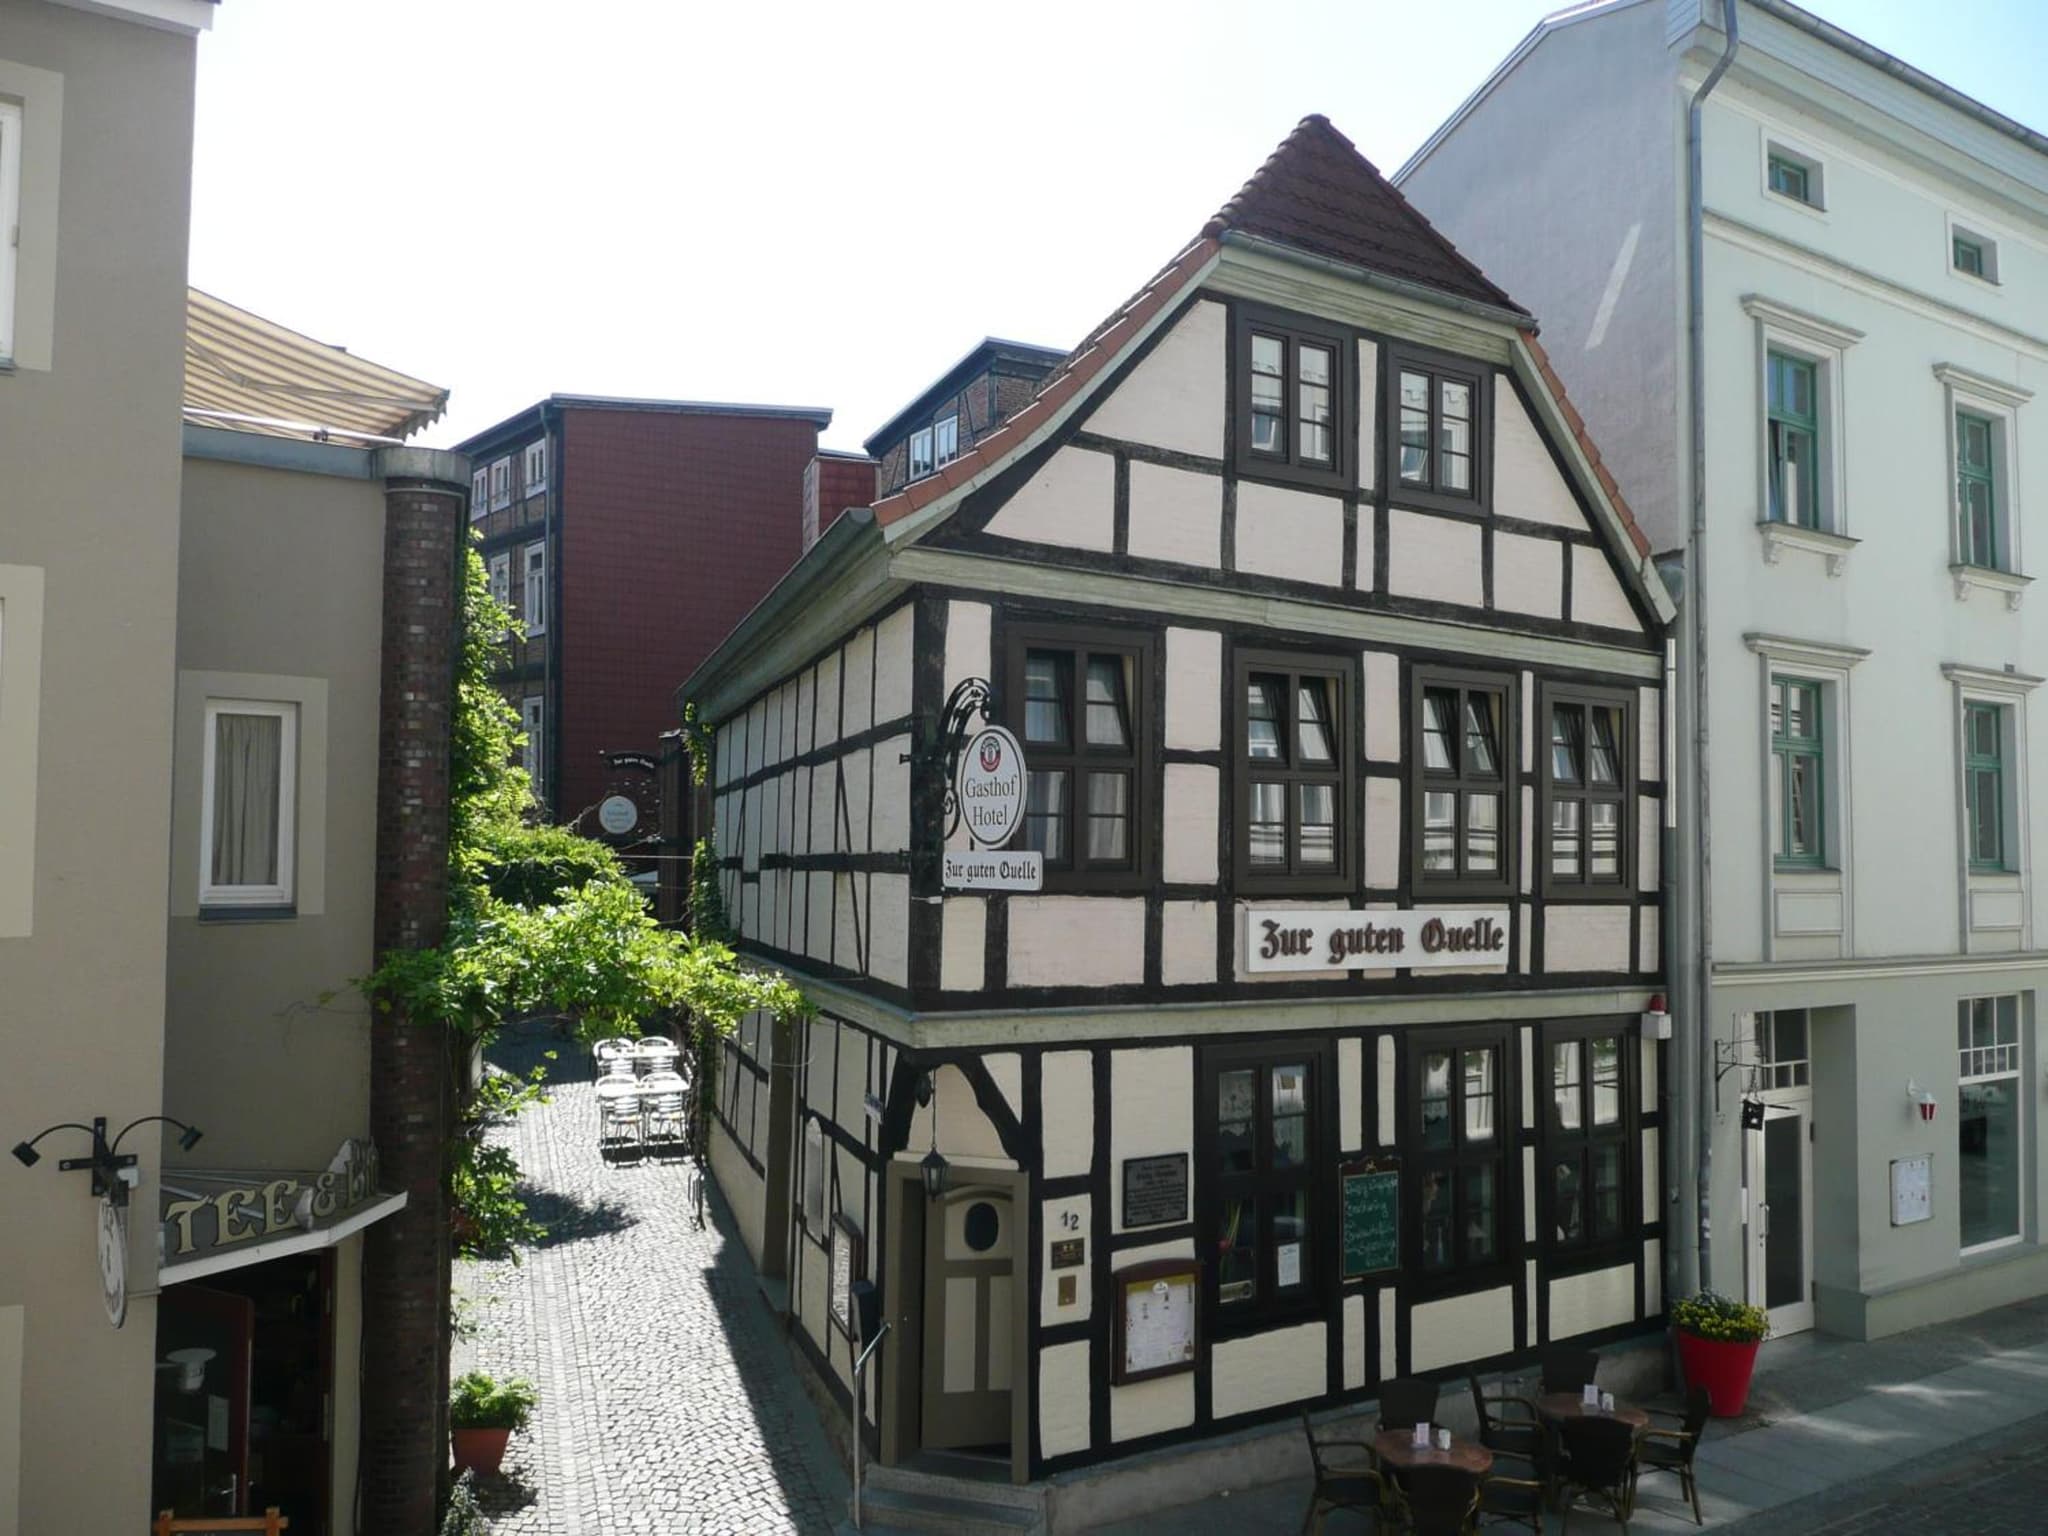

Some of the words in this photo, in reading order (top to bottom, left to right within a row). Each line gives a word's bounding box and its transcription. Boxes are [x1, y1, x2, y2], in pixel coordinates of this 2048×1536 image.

[965, 774, 1018, 799] Gasthof
[973, 805, 1008, 827] Hotel
[945, 859, 963, 879] Zur
[966, 863, 996, 883] guten
[999, 858, 1036, 880] Quelle
[1260, 918, 1314, 960] Zur
[1327, 921, 1405, 965] guten
[1421, 917, 1504, 954] Quelle
[165, 1178, 298, 1256] TEE
[1060, 1210, 1079, 1231] 12
